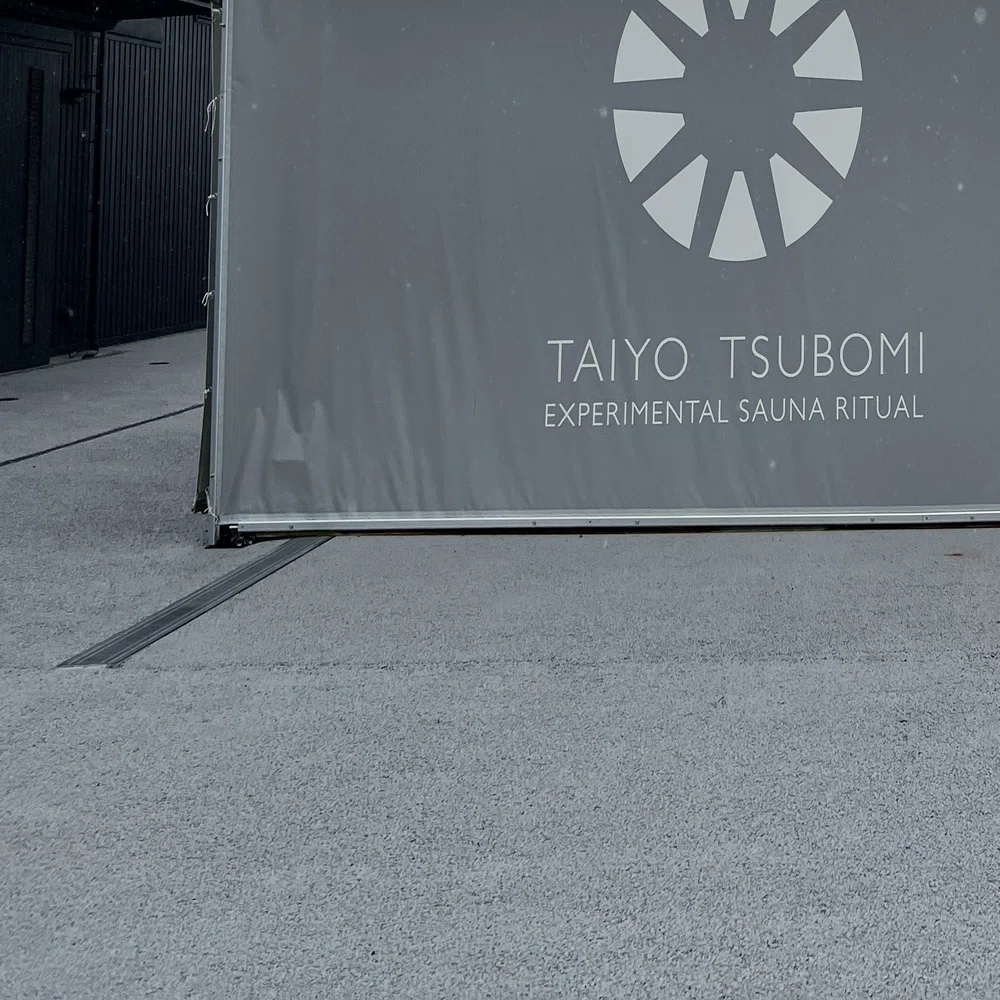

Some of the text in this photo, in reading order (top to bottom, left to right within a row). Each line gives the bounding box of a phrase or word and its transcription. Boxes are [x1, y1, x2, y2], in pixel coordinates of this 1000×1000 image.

[547, 331, 924, 383] TAIYO TSUBOMI
[544, 394, 924, 428] EXPERIMENTAL SAUNA RITUAL
